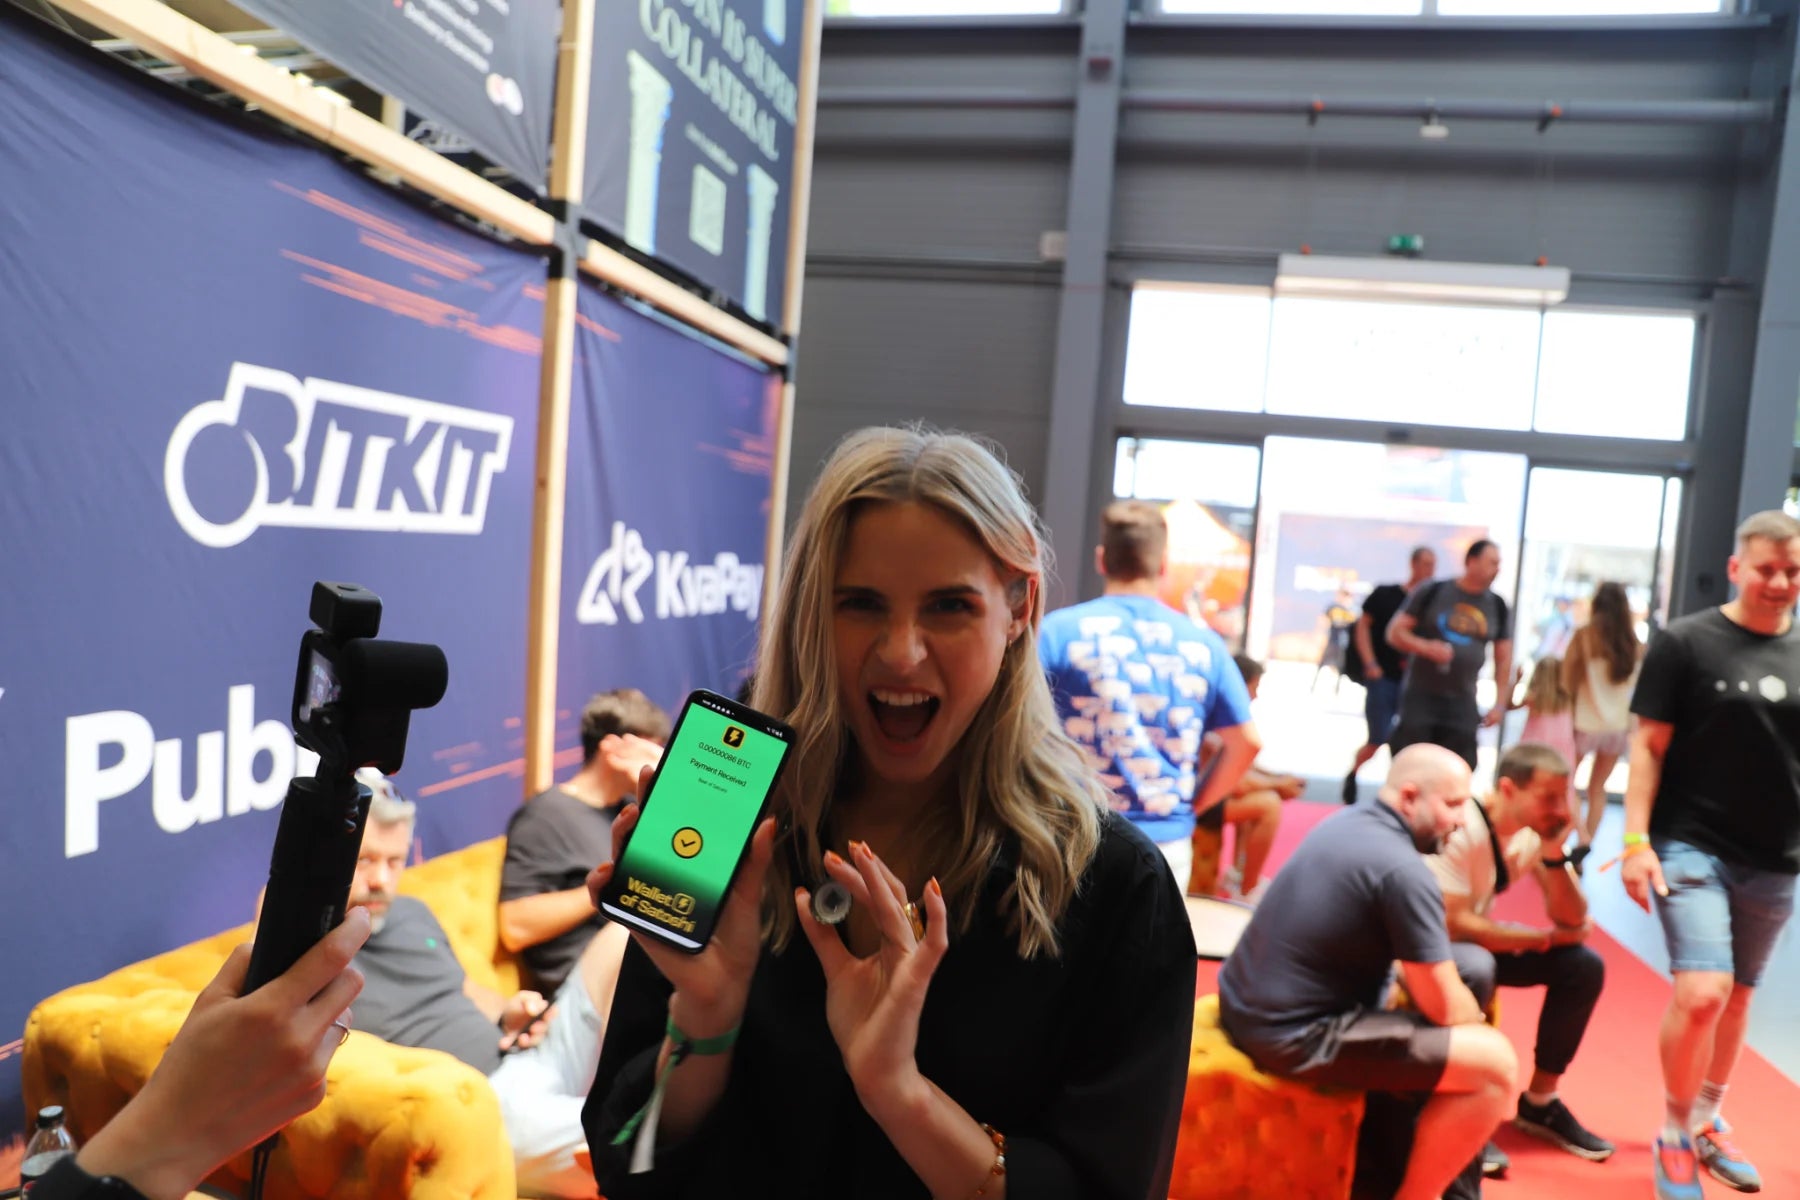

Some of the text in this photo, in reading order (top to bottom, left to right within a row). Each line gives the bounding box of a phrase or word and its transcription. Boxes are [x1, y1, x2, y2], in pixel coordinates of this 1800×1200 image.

[639, 0, 779, 161] COLLATERAL
[224, 361, 514, 535] BITKIT
[65, 683, 322, 858] Pub
[690, 757, 718, 775] Payment
[718, 769, 747, 787] Received
[736, 758, 751, 769] BTC
[628, 876, 673, 907] Wallet
[619, 894, 696, 933] of Satoshi
